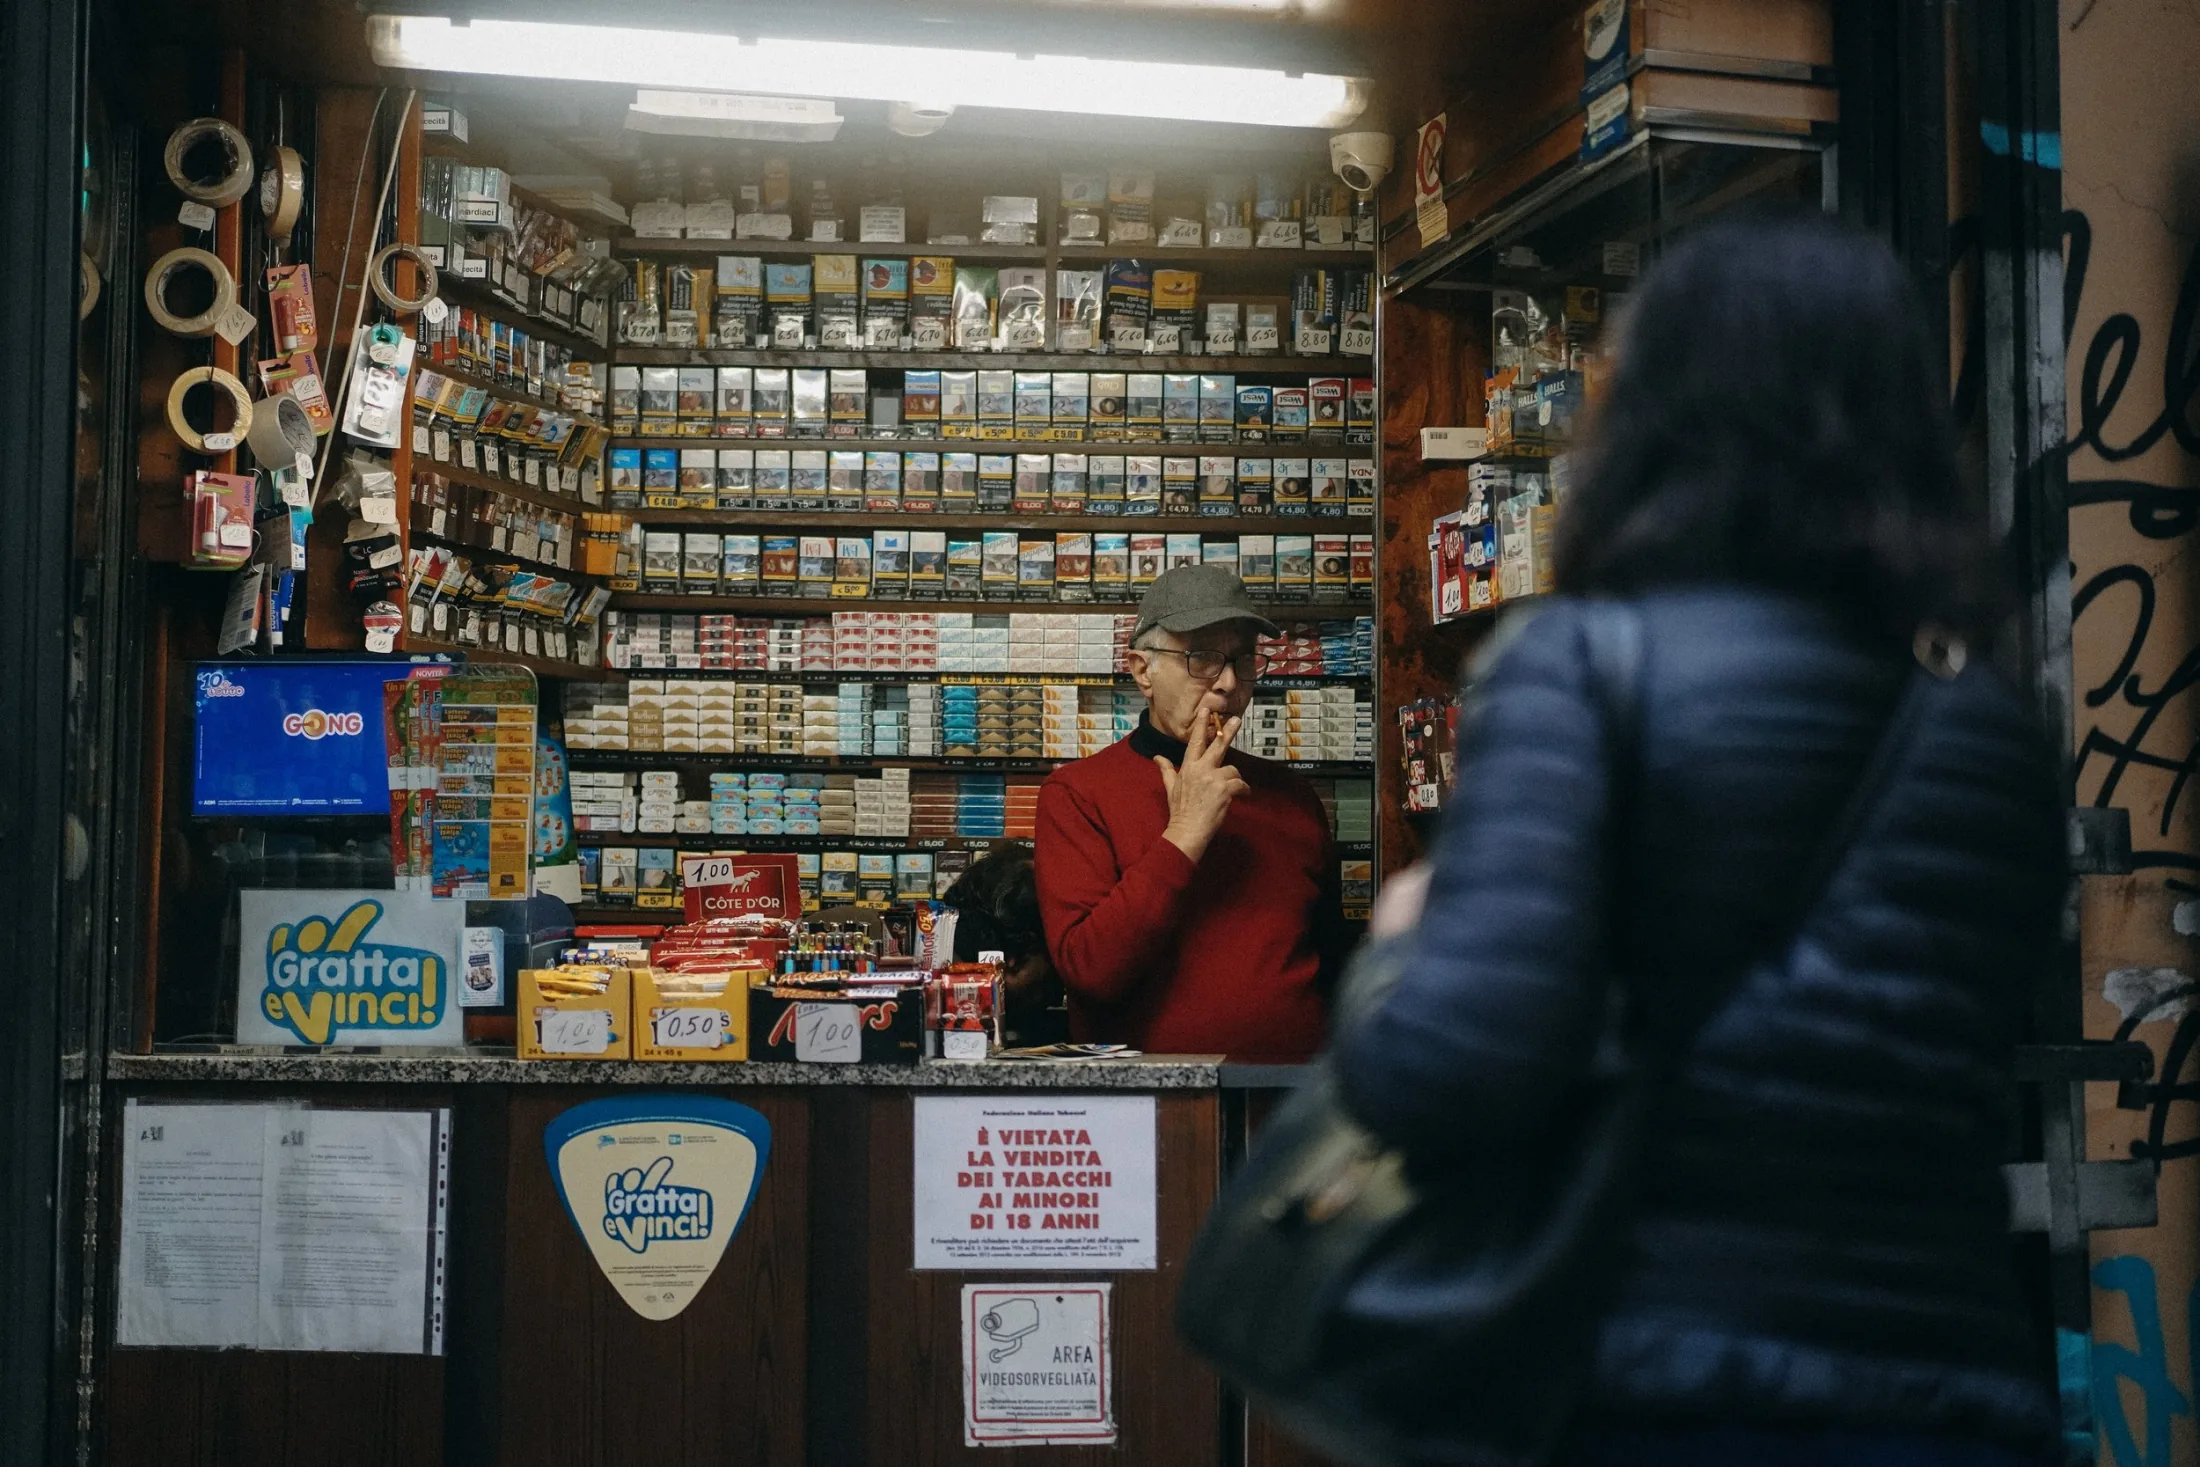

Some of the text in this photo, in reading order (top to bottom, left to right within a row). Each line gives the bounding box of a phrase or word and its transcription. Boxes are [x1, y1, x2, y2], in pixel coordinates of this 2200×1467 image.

[1325, 277, 1334, 317] DRUM
[1301, 333, 1328, 348] 8.80
[1345, 332, 1371, 348] 8.80
[1242, 393, 1266, 402] West
[1279, 395, 1302, 405] West
[1315, 387, 1339, 396] West
[362, 546, 372, 554] LC
[415, 668, 445, 678] NOVITÀ
[284, 709, 363, 740] GONG
[691, 862, 730, 883] 1.00
[705, 896, 743, 910] CÔTE
[272, 949, 419, 988] Gratta
[667, 1016, 714, 1040] 0.50
[977, 1126, 1092, 1146] È VIETATA
[967, 1150, 1102, 1167] LA VENDITA
[957, 1171, 1112, 1188] DEI TABACCHI
[608, 1187, 698, 1216] Gratta
[978, 1192, 1099, 1209] AI MINORI
[970, 1213, 1100, 1230] DI 18 ANNI
[980, 1371, 1097, 1386] VIDEOSORVEGLIATA
